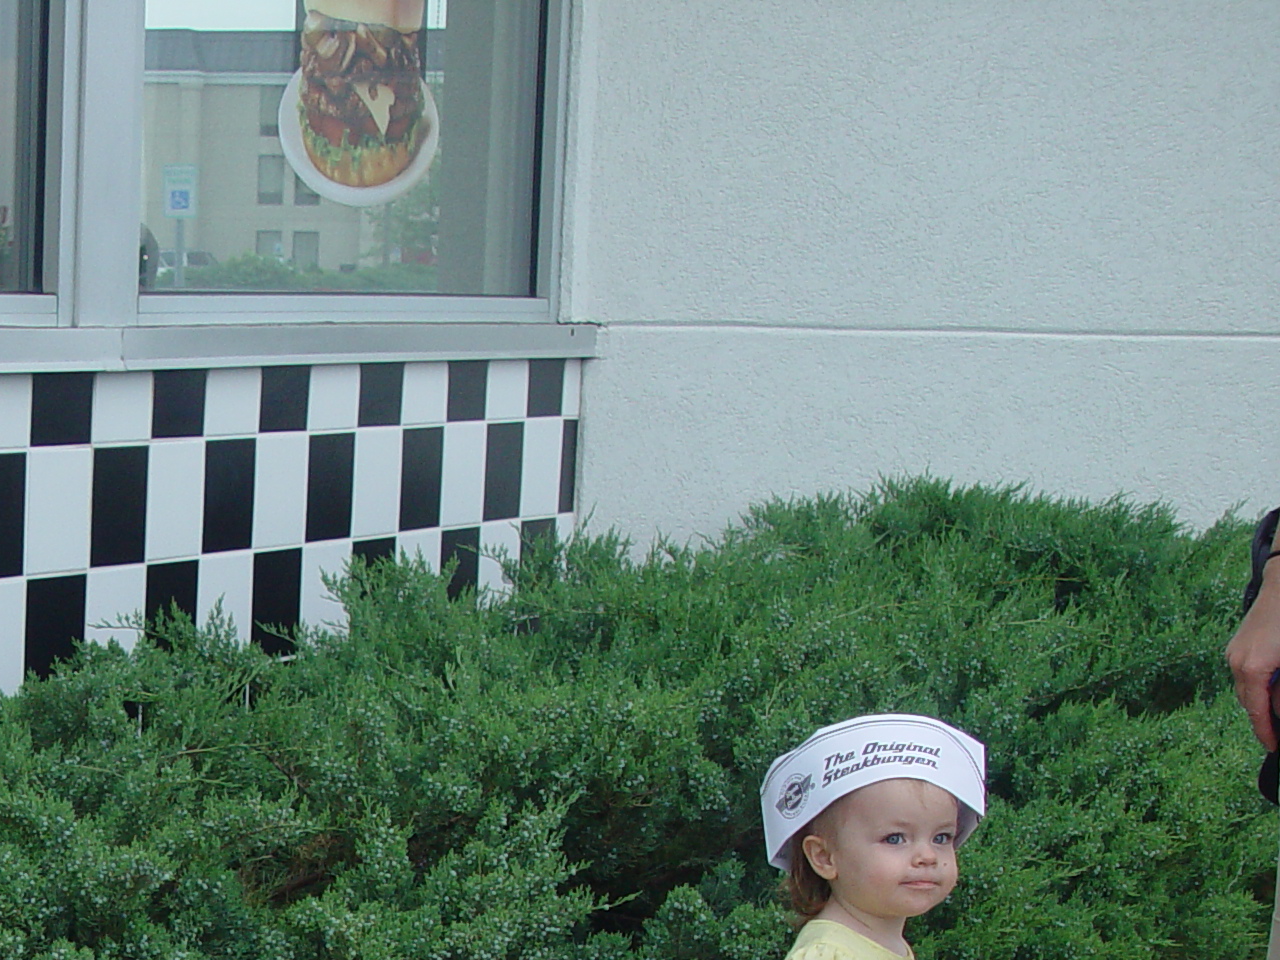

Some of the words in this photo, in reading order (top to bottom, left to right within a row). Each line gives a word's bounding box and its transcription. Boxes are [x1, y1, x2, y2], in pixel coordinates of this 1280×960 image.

[822, 754, 938, 788] Steakburger
[824, 751, 855, 770] The
[862, 742, 940, 758] Original
